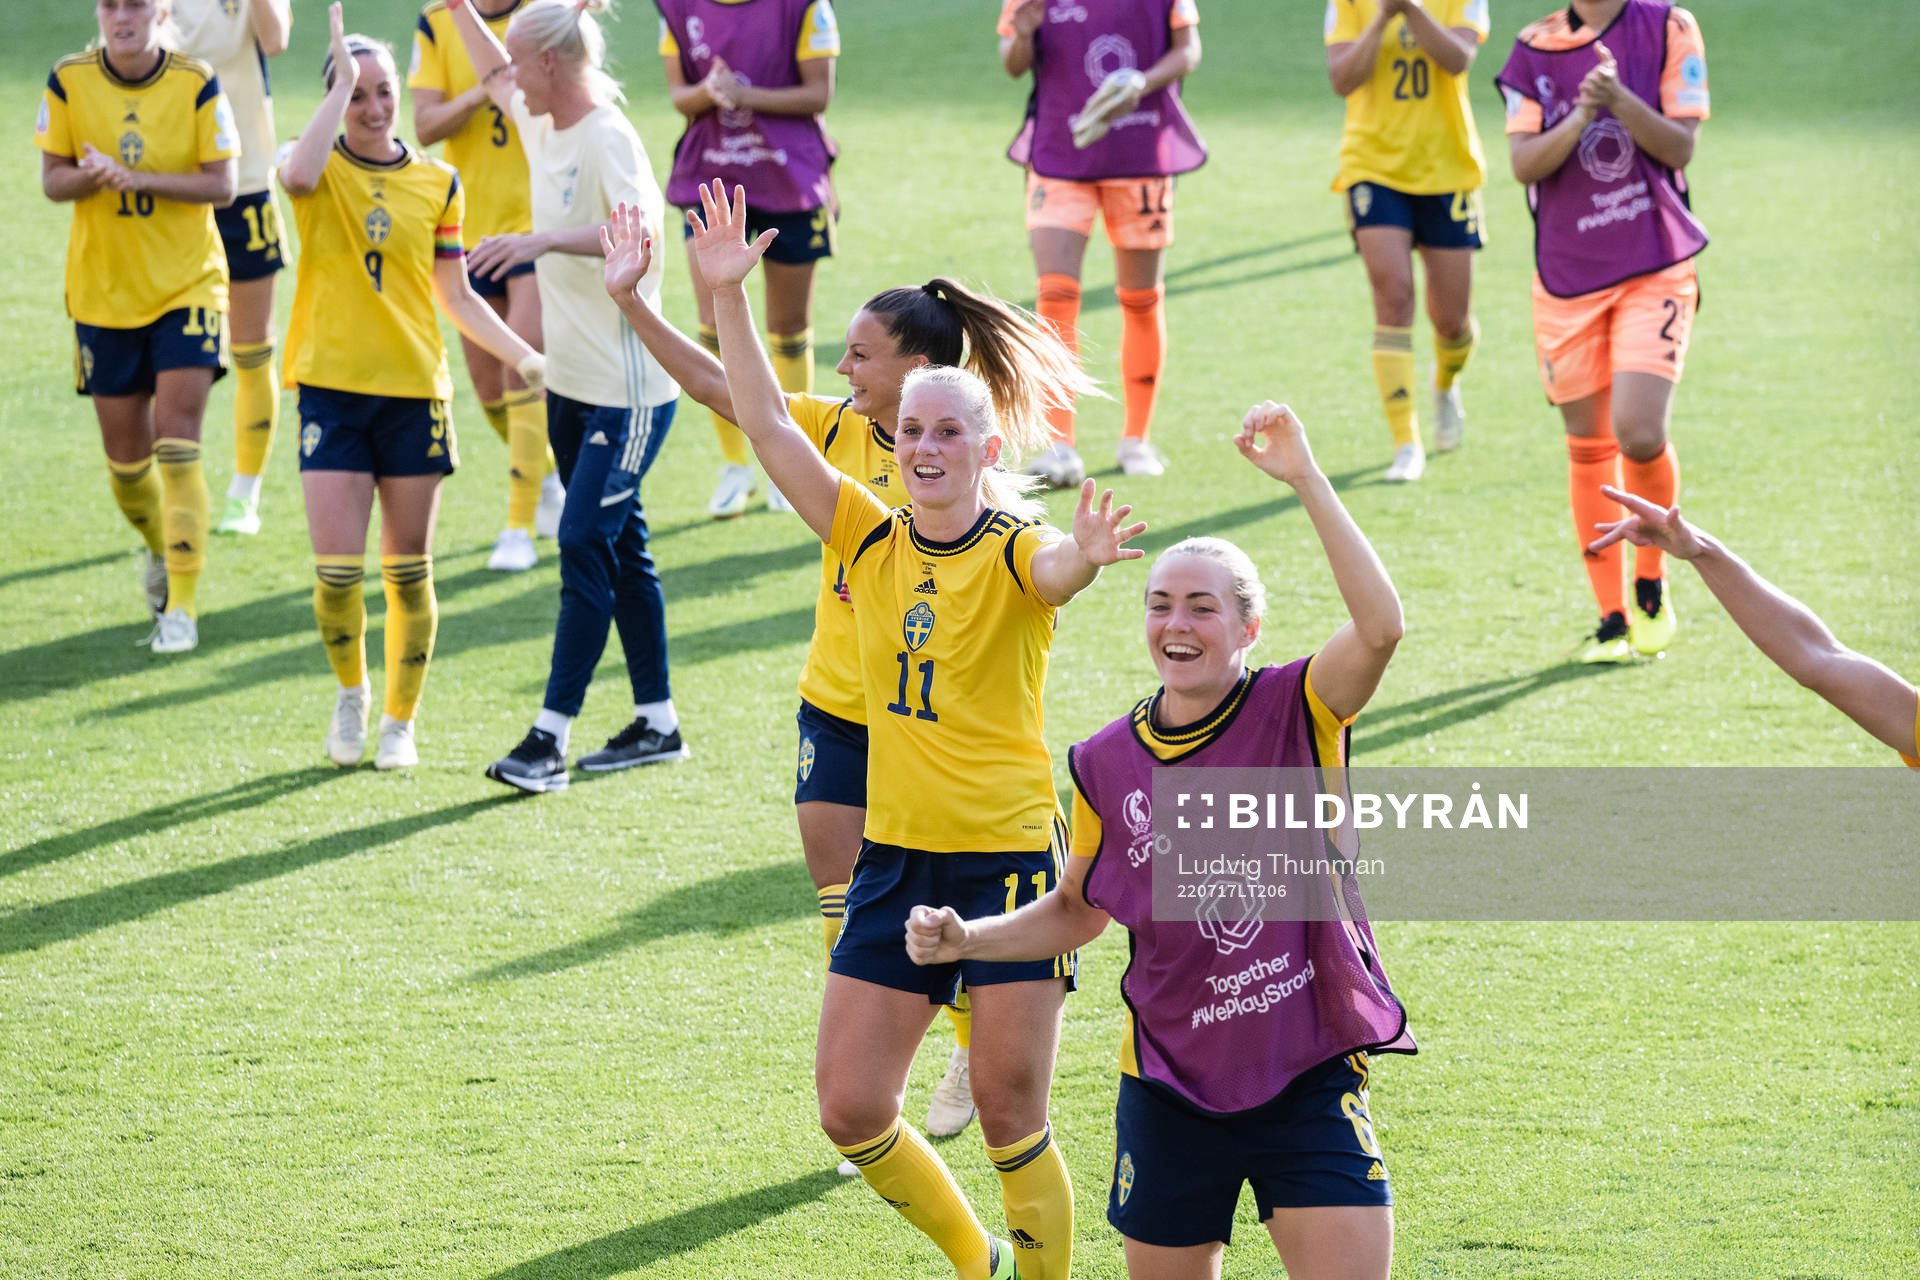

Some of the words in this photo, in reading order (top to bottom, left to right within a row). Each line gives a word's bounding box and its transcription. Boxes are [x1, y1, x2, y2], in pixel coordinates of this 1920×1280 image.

[1393, 58, 1430, 100] 20
[488, 104, 509, 148] 3
[242, 202, 280, 252] 10
[364, 250, 383, 292] 9
[887, 651, 939, 723] 11
[1004, 871, 1046, 915] 11
[1205, 952, 1291, 996] Together
